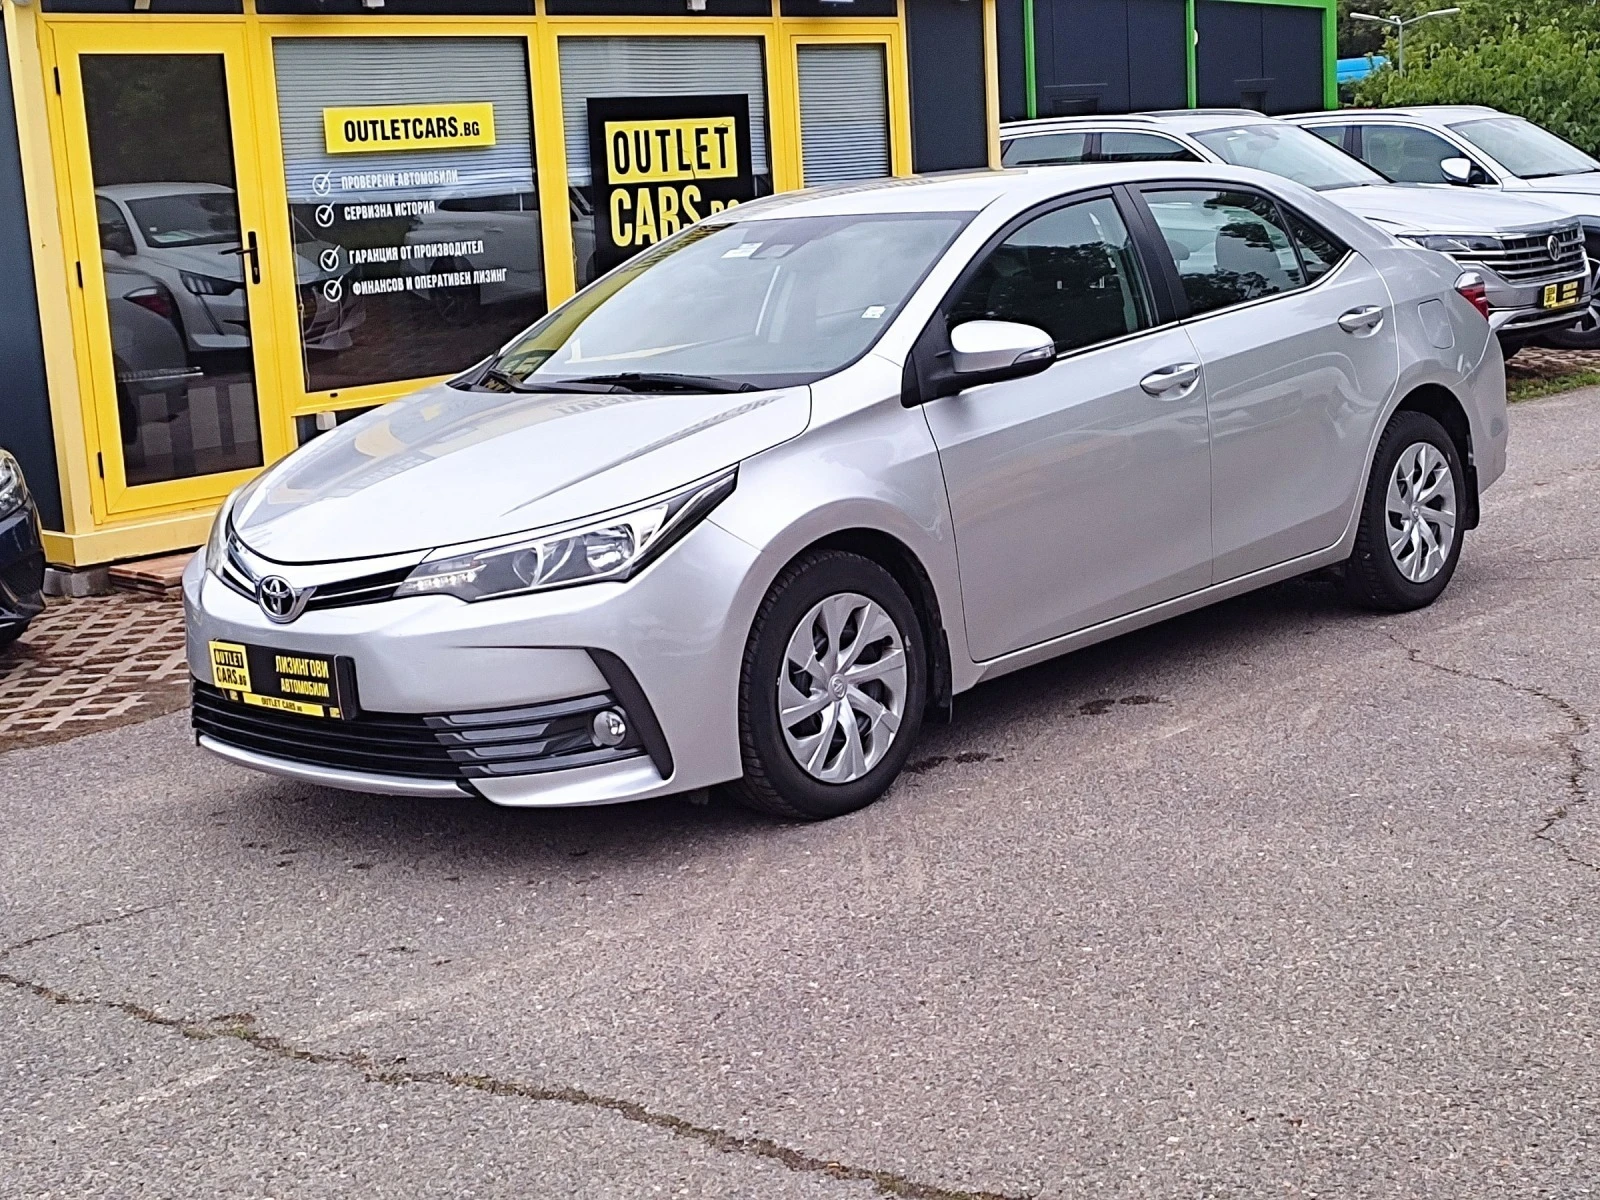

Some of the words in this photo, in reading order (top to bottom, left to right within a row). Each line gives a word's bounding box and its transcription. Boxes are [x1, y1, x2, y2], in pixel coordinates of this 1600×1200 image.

[344, 116, 480, 142] OUTLETCARS.BG
[613, 127, 729, 175] OUTLET
[341, 172, 395, 190] ПРОВЕРЕНИ
[397, 169, 459, 187] АВТОМОБИЛИ
[344, 203, 394, 221] СЕРВИЗНА
[394, 200, 436, 217] ИСТОРИЯ
[349, 248, 399, 265] ГАРАНЦИЯ
[400, 246, 413, 260] ОТ
[414, 240, 484, 259] ПРОИЗВОДИТЕЛ
[352, 278, 404, 296] ФИНАНСОВ
[405, 277, 413, 291] И
[414, 272, 472, 290] ОПЕРАТИВЕН
[472, 268, 508, 284] ЛИЗИНГ
[215, 650, 243, 667] OUTLET
[275, 654, 330, 679] ЛИЗИНГОВИ
[280, 677, 330, 698] АВТОМОБИЛИ
